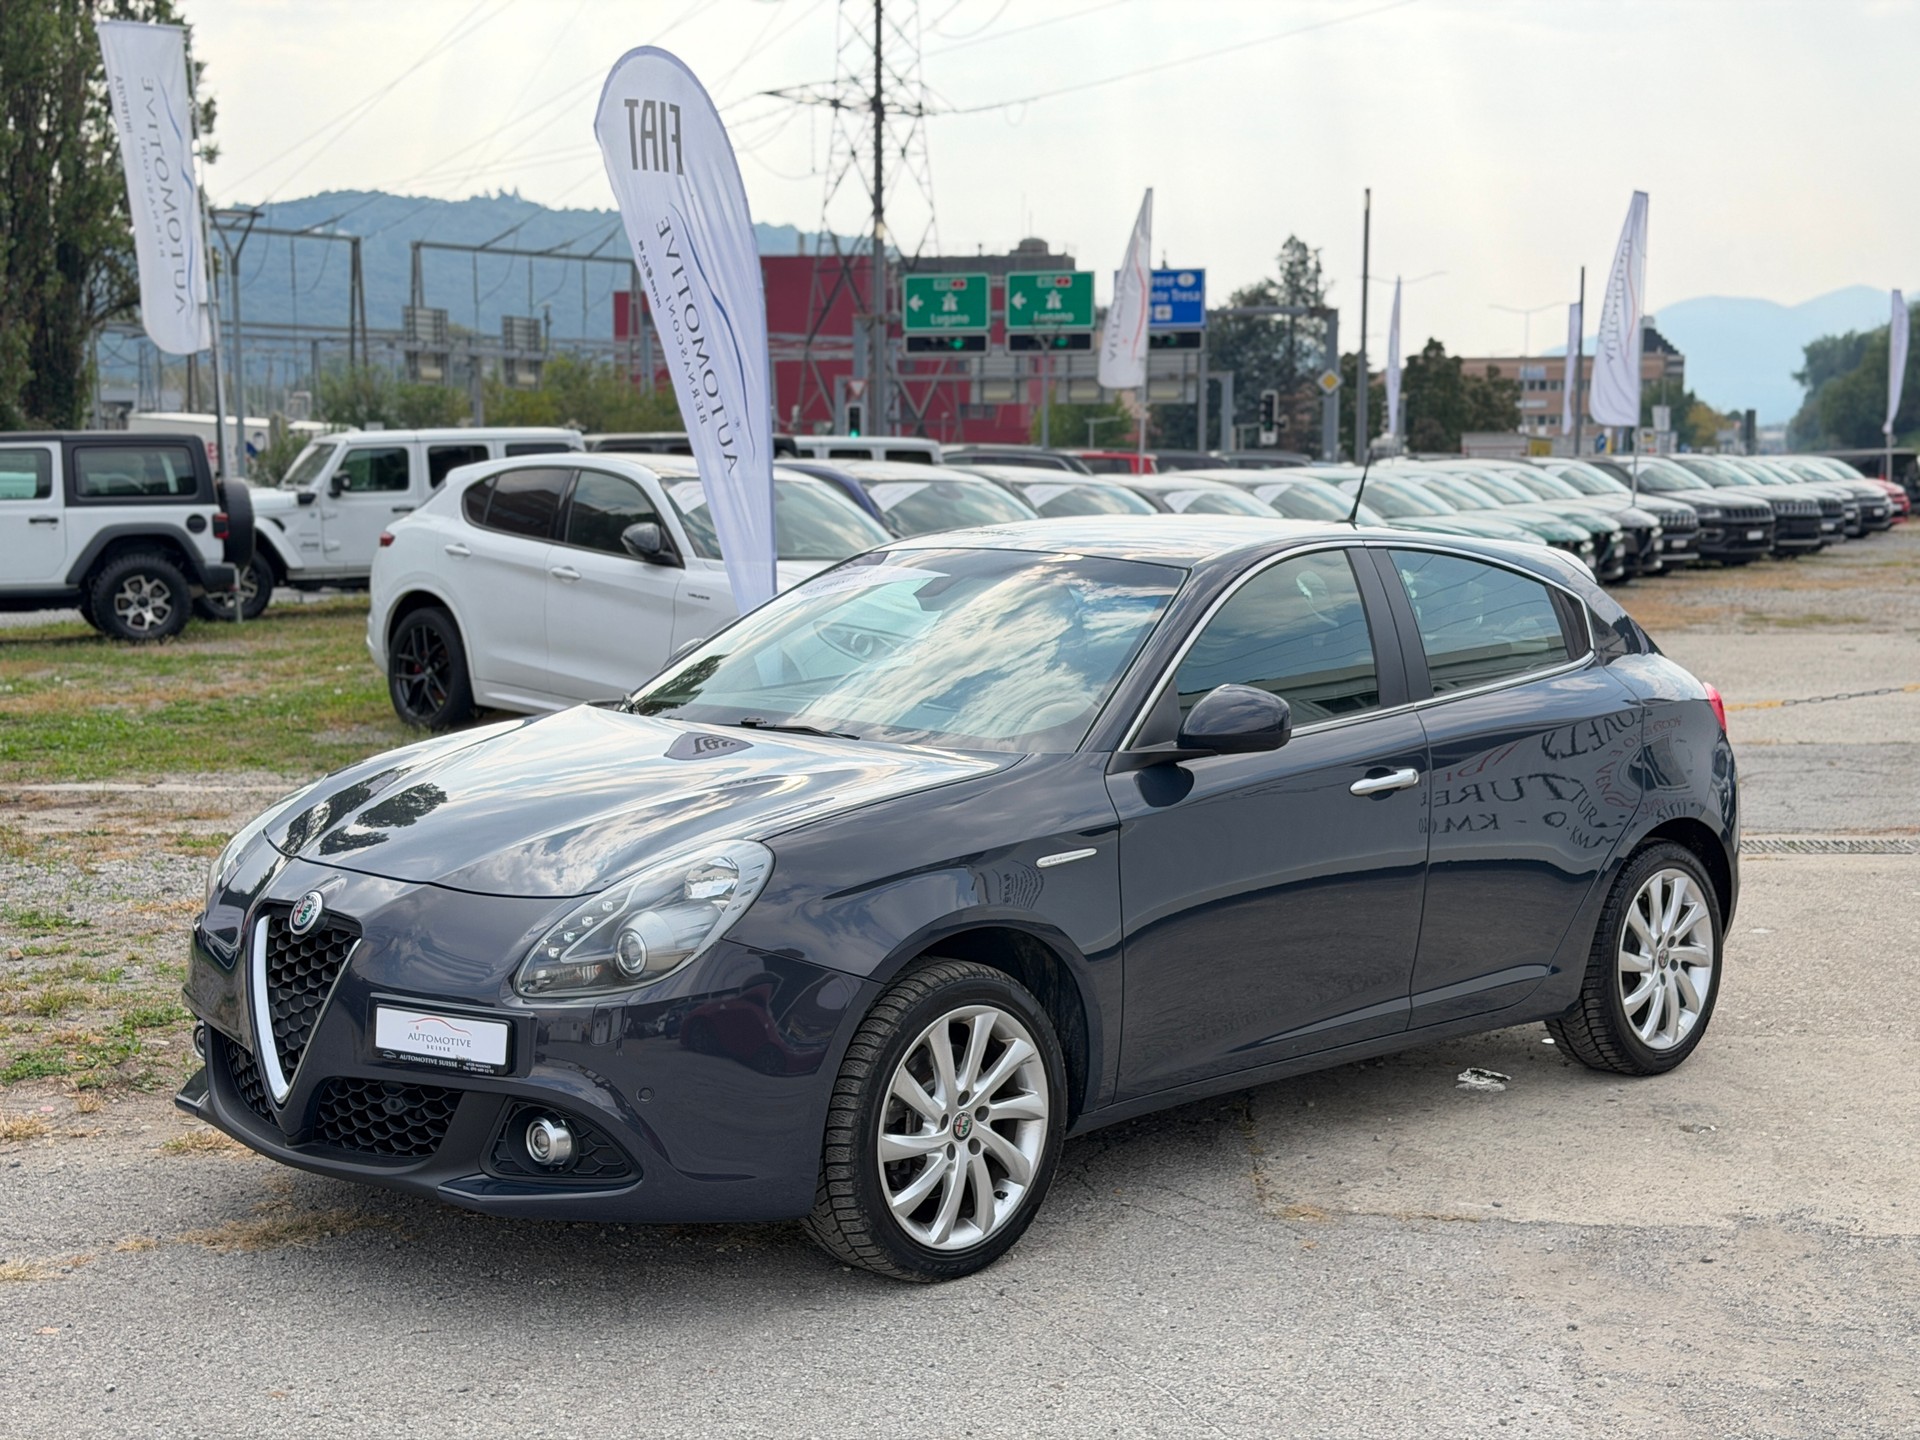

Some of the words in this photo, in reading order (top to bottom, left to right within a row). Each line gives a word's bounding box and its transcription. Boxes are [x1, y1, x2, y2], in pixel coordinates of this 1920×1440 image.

[407, 1032, 472, 1048] AUTOMOTIVE
[426, 1044, 451, 1053] SUISSE
[399, 1053, 437, 1065] AUTOMOTIVE
[438, 1059, 458, 1068] SUISSE
